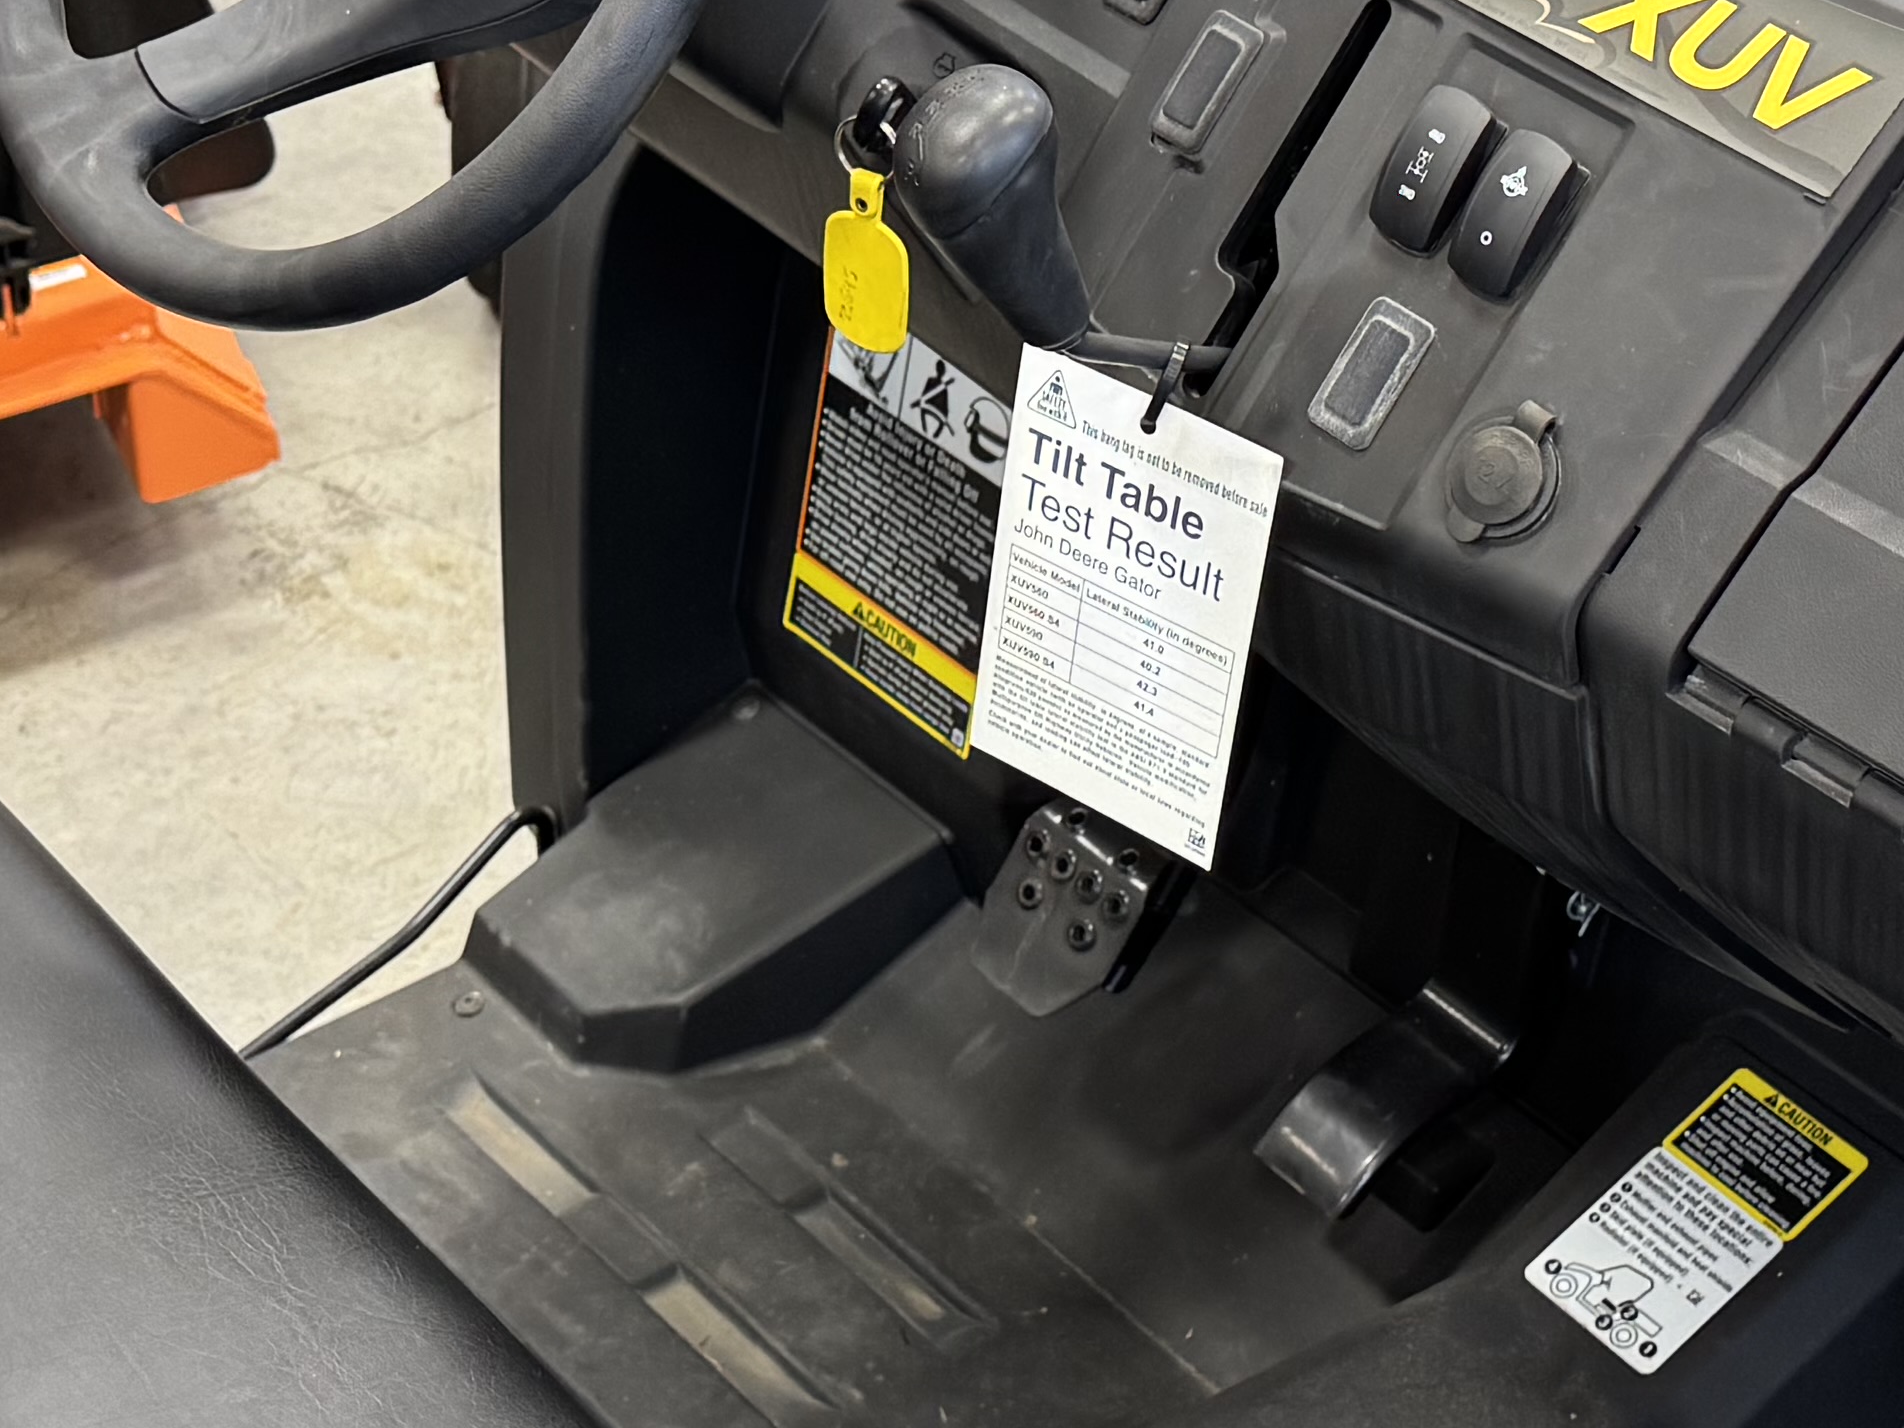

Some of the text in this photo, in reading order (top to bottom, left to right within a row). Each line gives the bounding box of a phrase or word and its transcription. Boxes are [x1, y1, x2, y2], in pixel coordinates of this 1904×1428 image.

[1029, 428, 1203, 539] Tilt Table
[1014, 518, 1161, 599] John Deere Gator
[1022, 473, 1222, 601] Test Result
[865, 610, 916, 657] CAUTION
[1778, 1102, 1832, 1145] CAUTION
